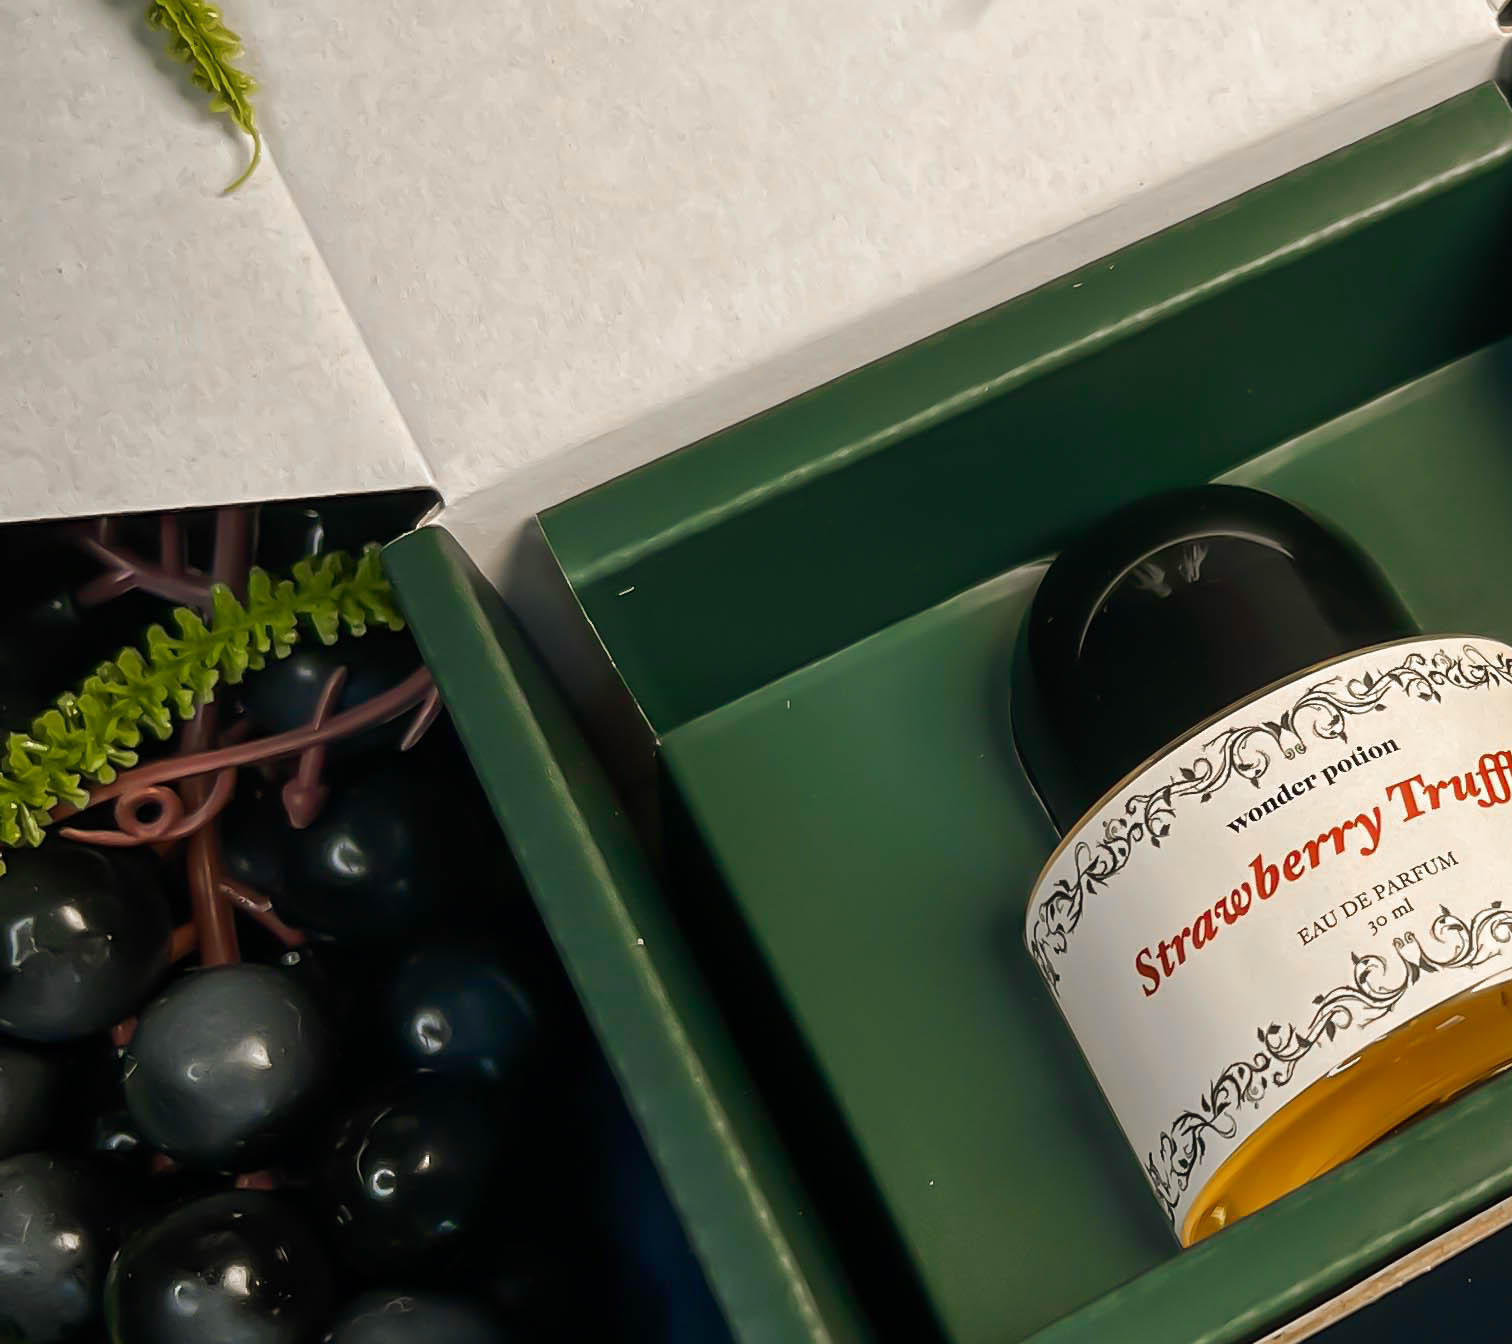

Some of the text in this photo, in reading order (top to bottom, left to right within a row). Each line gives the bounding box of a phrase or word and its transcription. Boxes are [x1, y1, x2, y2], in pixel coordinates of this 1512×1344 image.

[1226, 737, 1401, 835] wonder potion
[1134, 805, 1382, 997] Strawberry
[1297, 850, 1460, 946] EAU DE PARFUM
[1367, 896, 1415, 937] 30 ml
